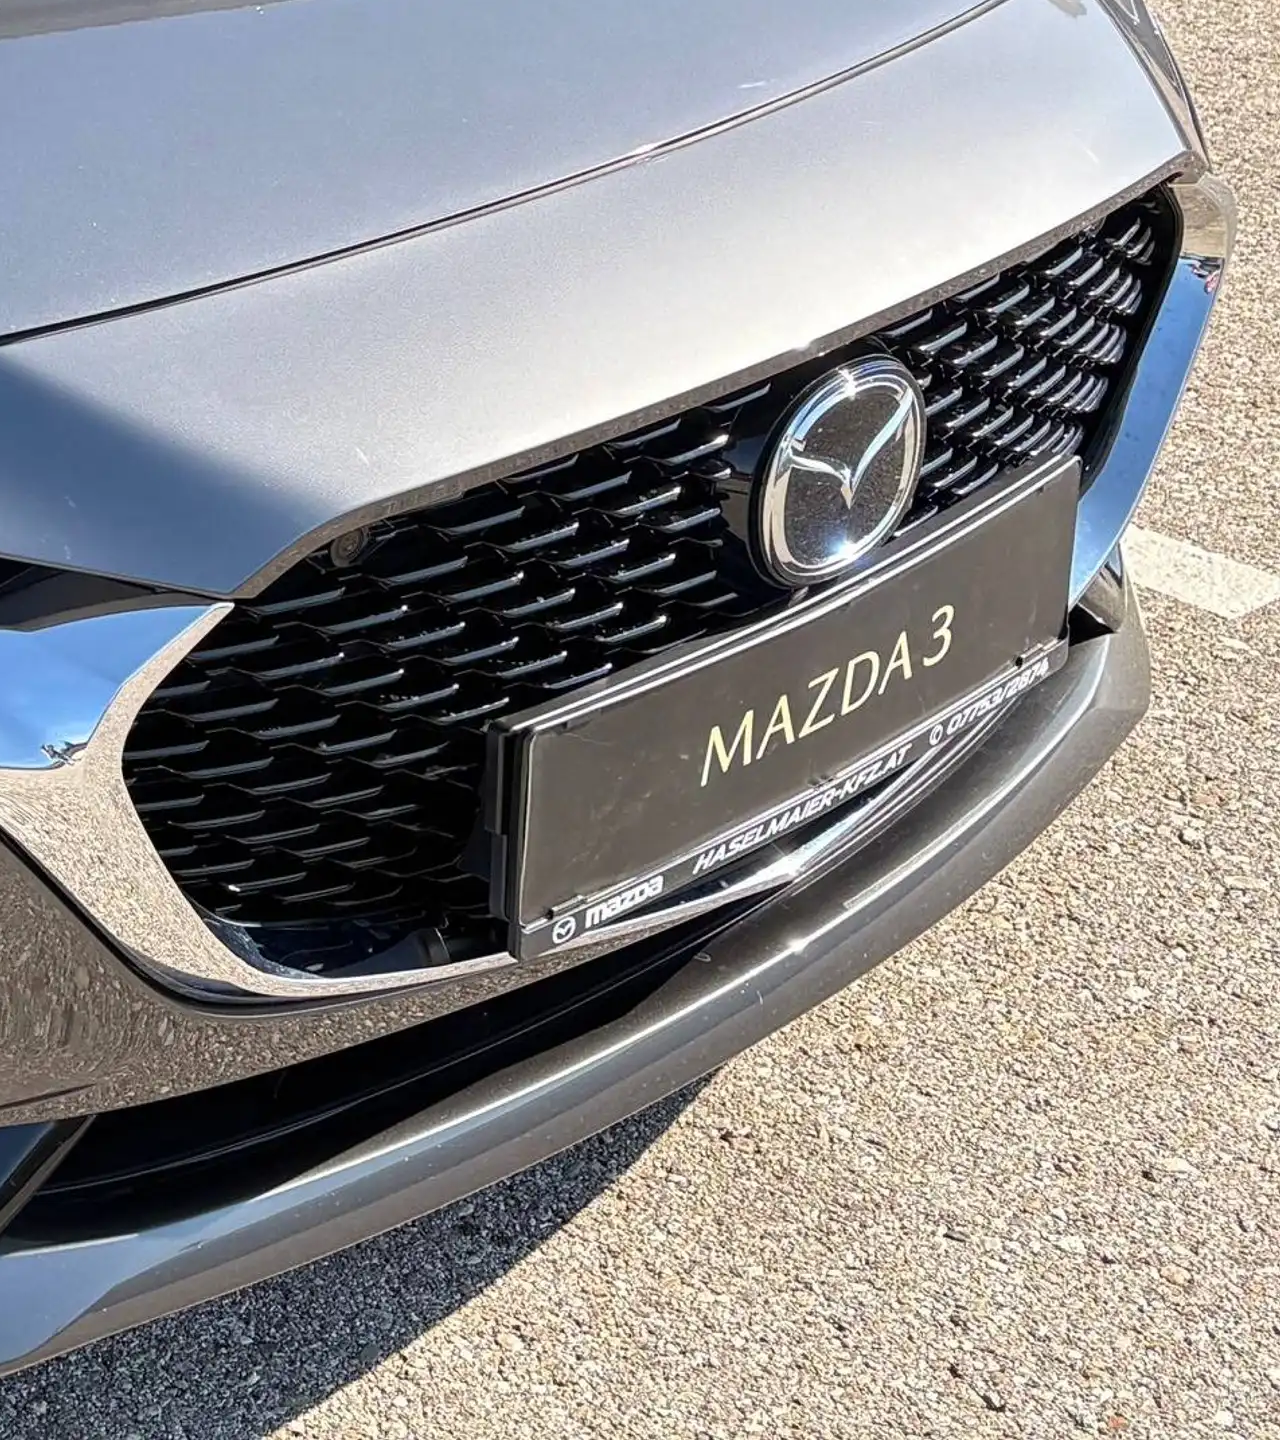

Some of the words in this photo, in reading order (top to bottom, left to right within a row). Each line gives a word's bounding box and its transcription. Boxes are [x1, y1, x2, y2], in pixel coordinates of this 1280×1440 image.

[584, 875, 665, 928] mazda
[692, 744, 914, 876] HASELMAIER-KFZ.AT
[946, 658, 1050, 736] 07753/2874
